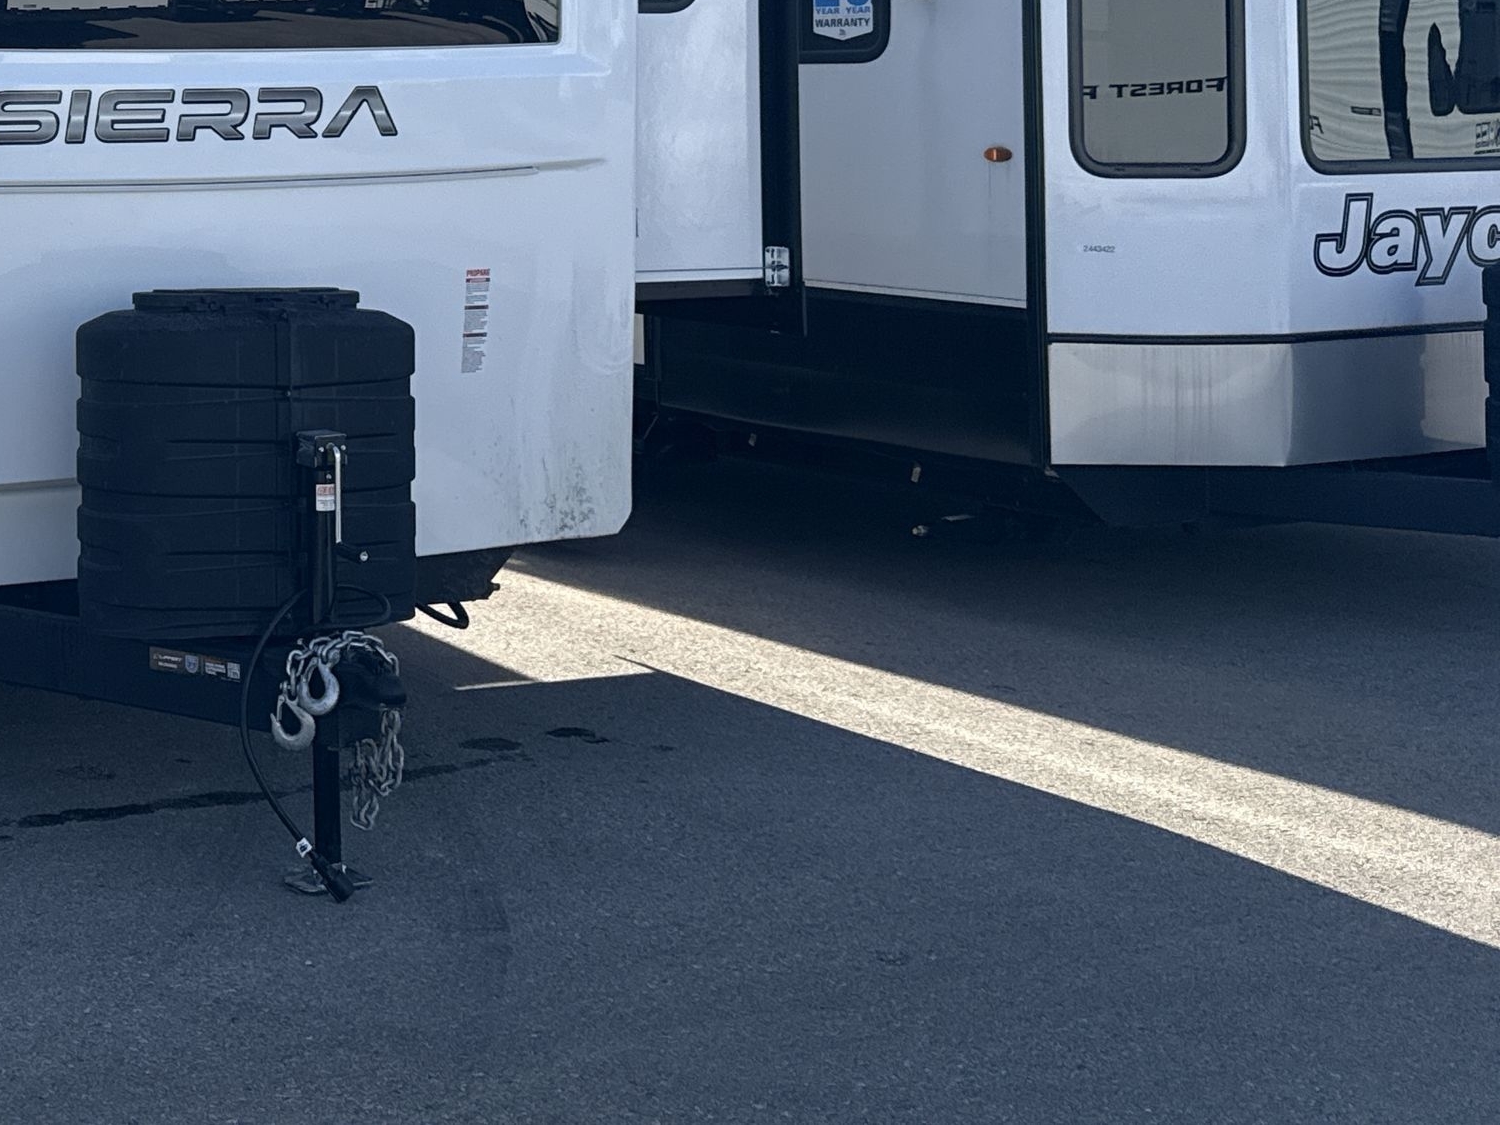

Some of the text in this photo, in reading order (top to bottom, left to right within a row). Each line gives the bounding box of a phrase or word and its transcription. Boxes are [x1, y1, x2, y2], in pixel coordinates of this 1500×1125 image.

[815, 6, 871, 15] YEAR YEAR
[815, 18, 871, 27] WARRANTY
